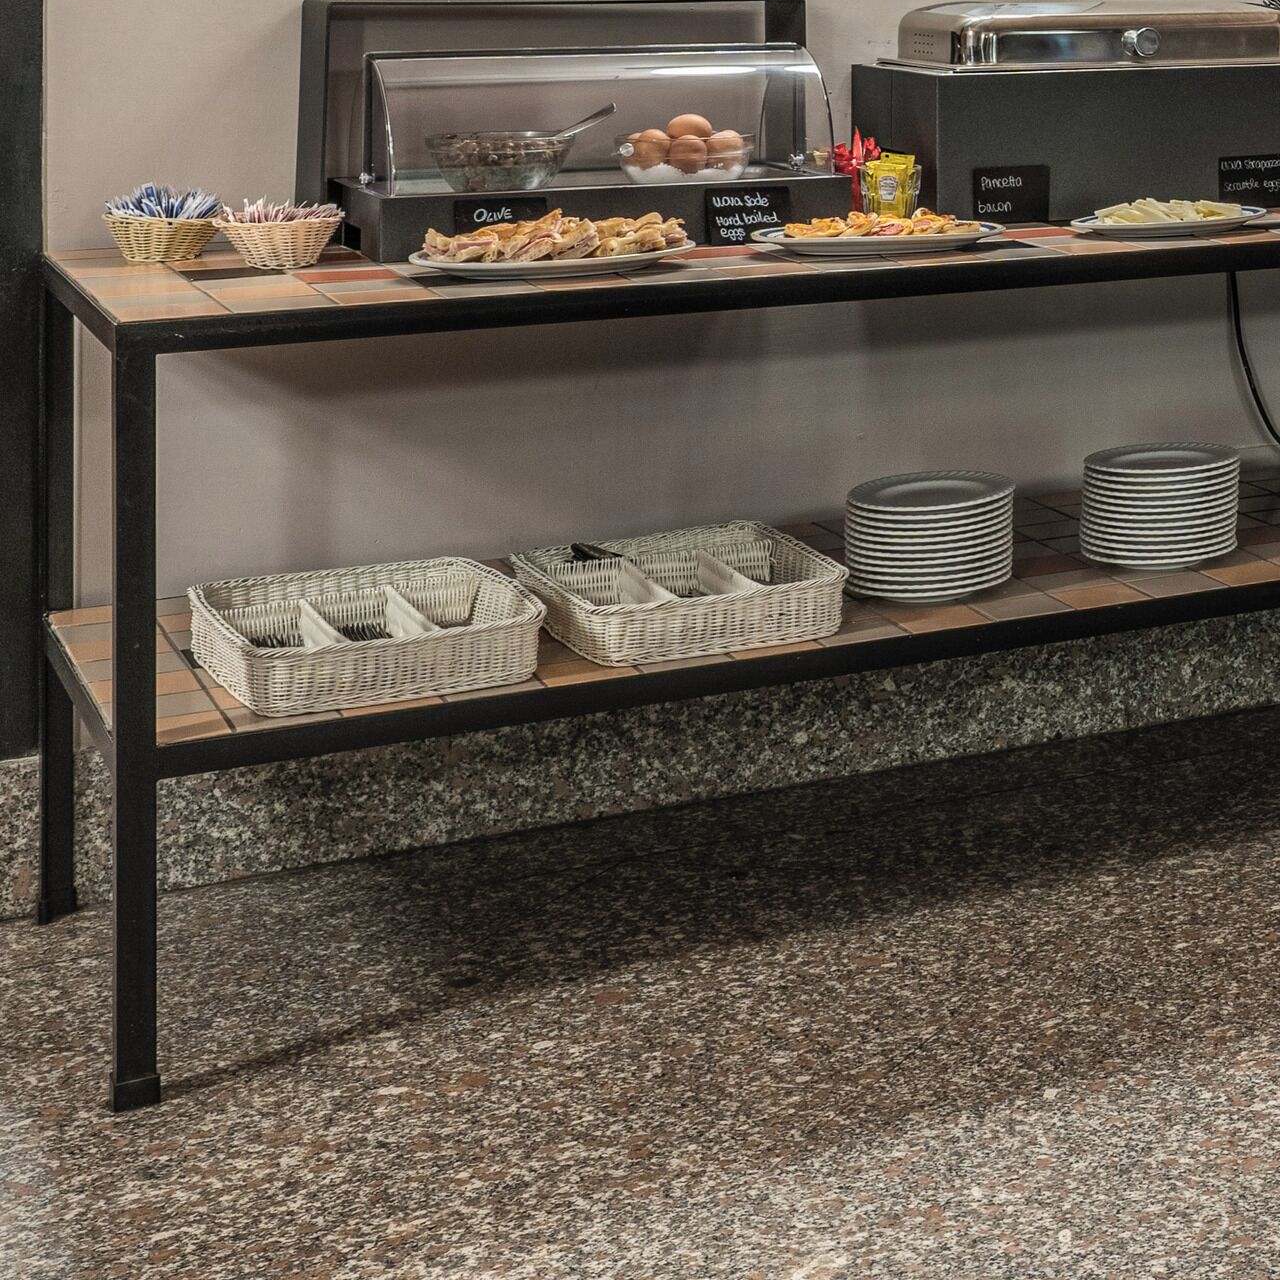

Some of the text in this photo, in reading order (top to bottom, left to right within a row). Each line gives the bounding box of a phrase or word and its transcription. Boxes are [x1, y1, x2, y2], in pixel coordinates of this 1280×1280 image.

[981, 175, 1023, 191] Pancetta
[473, 206, 513, 223] OLIVE
[978, 200, 1012, 214] bacon
[742, 209, 781, 225] boiled
[720, 227, 746, 241] eggs
